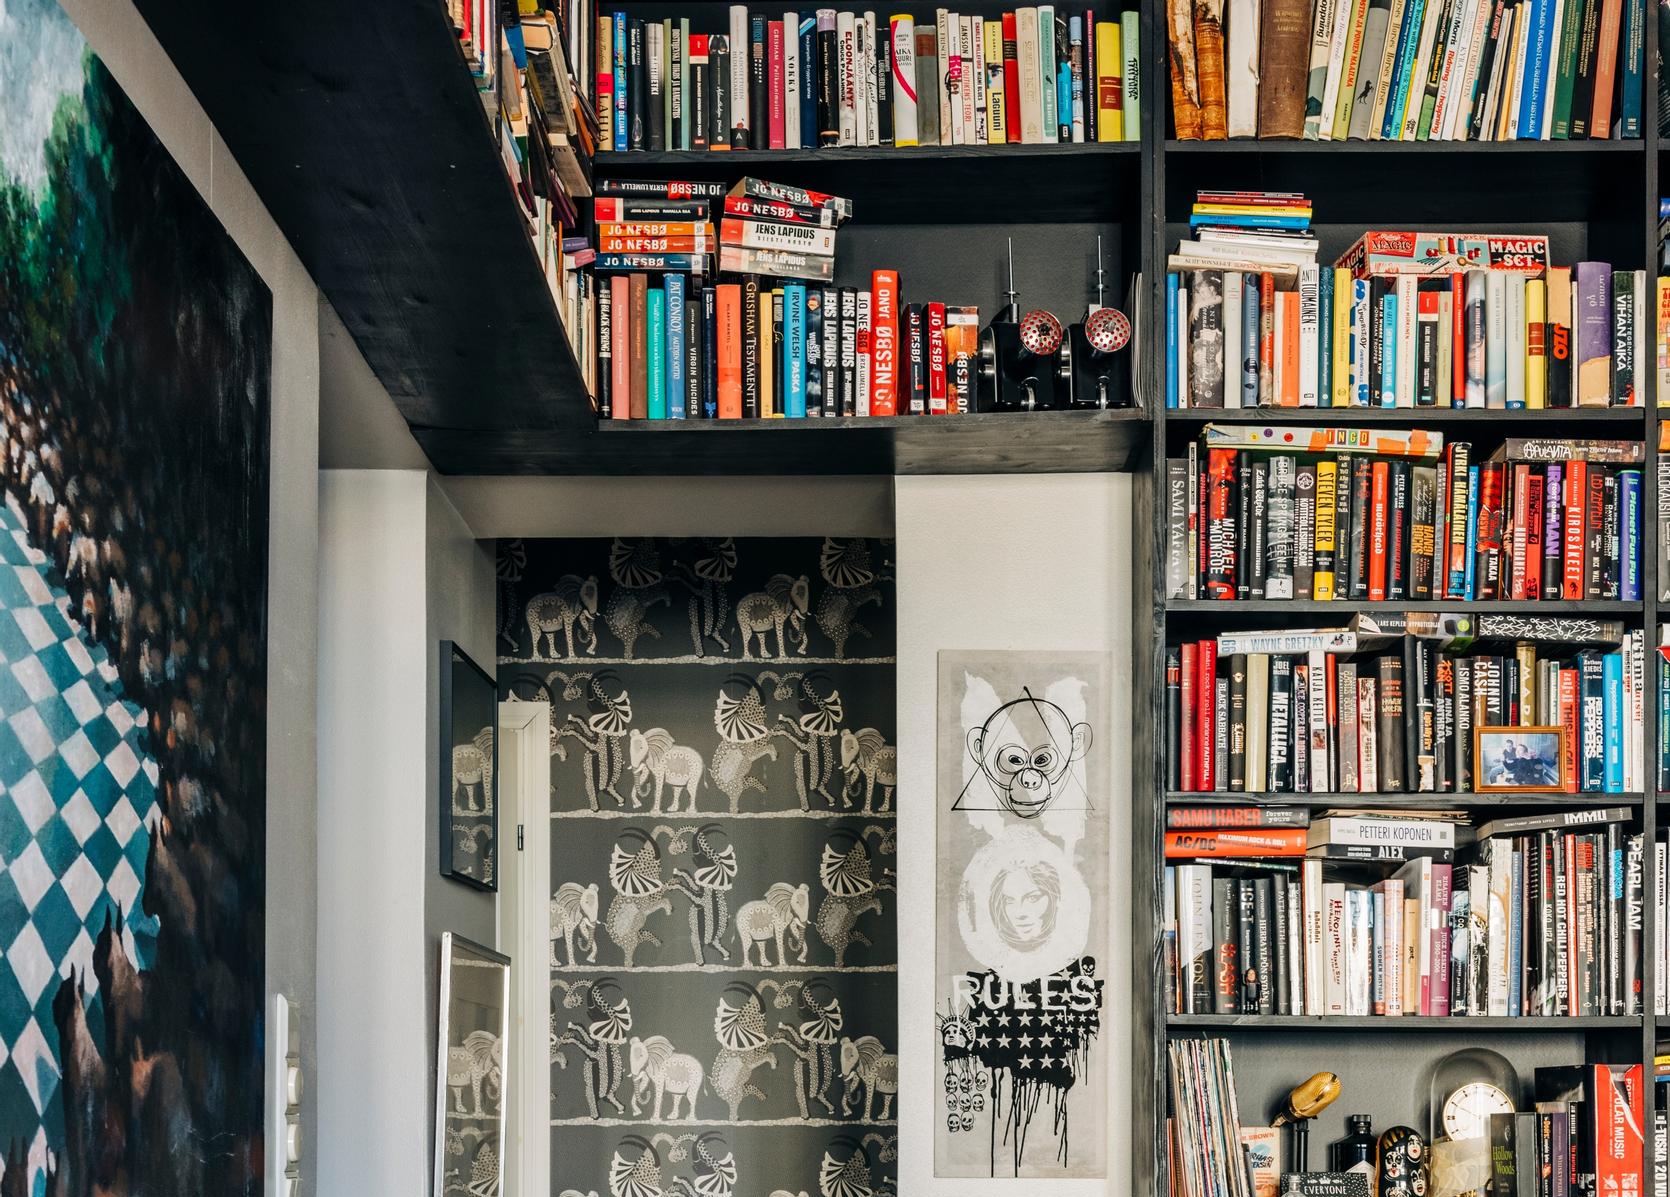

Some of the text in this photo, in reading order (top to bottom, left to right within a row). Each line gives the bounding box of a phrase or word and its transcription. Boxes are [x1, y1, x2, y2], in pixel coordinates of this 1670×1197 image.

[939, 13, 947, 29] MAX
[961, 25, 969, 55] JANSSON
[1450, 20, 1462, 46] Morris
[844, 31, 854, 110] ELOONJÄÄNYT
[1346, 30, 1361, 88] PONIEN MAAILMA
[1378, 22, 1401, 107] Horses Horses Horses
[1442, 50, 1456, 83] Ridning
[1528, 0, 1548, 134] SUOMEN RATSASTUSURHEILUN HISTORIA
[963, 65, 972, 123] POLITIKENS TEORI
[1431, 95, 1447, 136] hoppning
[709, 184, 722, 196] JO
[733, 201, 795, 218] JO NESBØ
[752, 183, 810, 204] JO NESBØ
[607, 224, 668, 235] JO NESBØ
[607, 239, 668, 251] JO NESBØ
[755, 223, 816, 240] JENS LAPIDUS
[1490, 240, 1546, 255] MAGIC
[603, 257, 665, 267] JO NESBØ
[755, 250, 807, 266] JENS LAPIDUS
[1502, 255, 1534, 268] SET
[600, 304, 610, 352] BLACK SPRING
[670, 281, 682, 334] PAT CONROY
[858, 298, 868, 348] JO NESBØ
[1301, 283, 1317, 325] TUOMAINEN
[746, 281, 757, 408] GRISHAM TESTAMENTTI
[792, 291, 800, 394] IRVINE WELSH PASKA
[824, 291, 837, 368] JENS LAPIDUS
[842, 291, 855, 368] JENS LAPIDUS
[875, 289, 893, 385] NESBØ JANO
[911, 312, 921, 364] JO NESBØ
[931, 311, 943, 373] JO NESBØ
[1553, 323, 1568, 360] UZO
[1616, 294, 1627, 371] VIHAN AIKA
[690, 347, 698, 416] VIRGIN SUICIDES
[957, 351, 969, 395] NESBØ
[1326, 430, 1370, 447] INGO
[1277, 461, 1289, 564] BRUCE SPRINGSTEEN
[1317, 472, 1334, 543] STEVEN TYLER
[1453, 447, 1469, 544] JYRKI HÄMÄLÄINEN
[1590, 473, 1603, 530] LED ZEPPELIN
[1171, 480, 1185, 567] SAMI YAFFA
[1222, 518, 1235, 571] MICHAEL
[1374, 503, 1385, 555] motörhead
[1412, 524, 1424, 555] ROCKS
[1423, 525, 1434, 556] HANOI
[1566, 506, 1581, 581] KIROSÄKEET
[1629, 491, 1637, 585] Planet Fun Fun
[1209, 525, 1223, 575] MONROE
[1489, 556, 1499, 581] TAKAA
[1513, 527, 1526, 576] HURRIGANES
[1312, 666, 1325, 723] KATJA KETTU
[1458, 667, 1470, 730] ISMO ALANKO
[1474, 661, 1487, 697] CASH
[1487, 660, 1500, 714] JOHNNY
[1217, 682, 1228, 749] BLACK SABBATH
[1271, 691, 1289, 764] METALLICA
[1436, 697, 1446, 744] ANTHRAX
[1444, 697, 1454, 737] MINÄ JA
[1584, 696, 1596, 759] PEPPERS
[1204, 746, 1212, 781] FAITHFULL
[1171, 808, 1262, 828] SAMU HABER
[1359, 825, 1433, 841] PETTERI KOPONEN
[1564, 809, 1608, 825] IMMU
[1175, 834, 1217, 852] AC/DC
[1378, 845, 1404, 859] ALEX
[1241, 887, 1254, 923] ICE-T
[1434, 879, 1443, 902] ELÄMÄ
[1442, 875, 1450, 907] RISAINEN
[1627, 841, 1643, 930] PEARL JAM
[1278, 890, 1286, 941] PATTI SMITH
[1555, 875, 1569, 999] RED HOT CHILI PEPPERS
[1220, 943, 1237, 997] SLASH
[1259, 919, 1271, 1002] HERRA YLPÖN SYDÄN
[1440, 931, 1449, 983] JUICE LESKINEN
[953, 973, 1097, 1014] RULES
[1613, 1127, 1626, 1159] MUSIC
[1303, 1185, 1348, 1195] EVERYONE
[1655, 1165, 1668, 1178] 20
